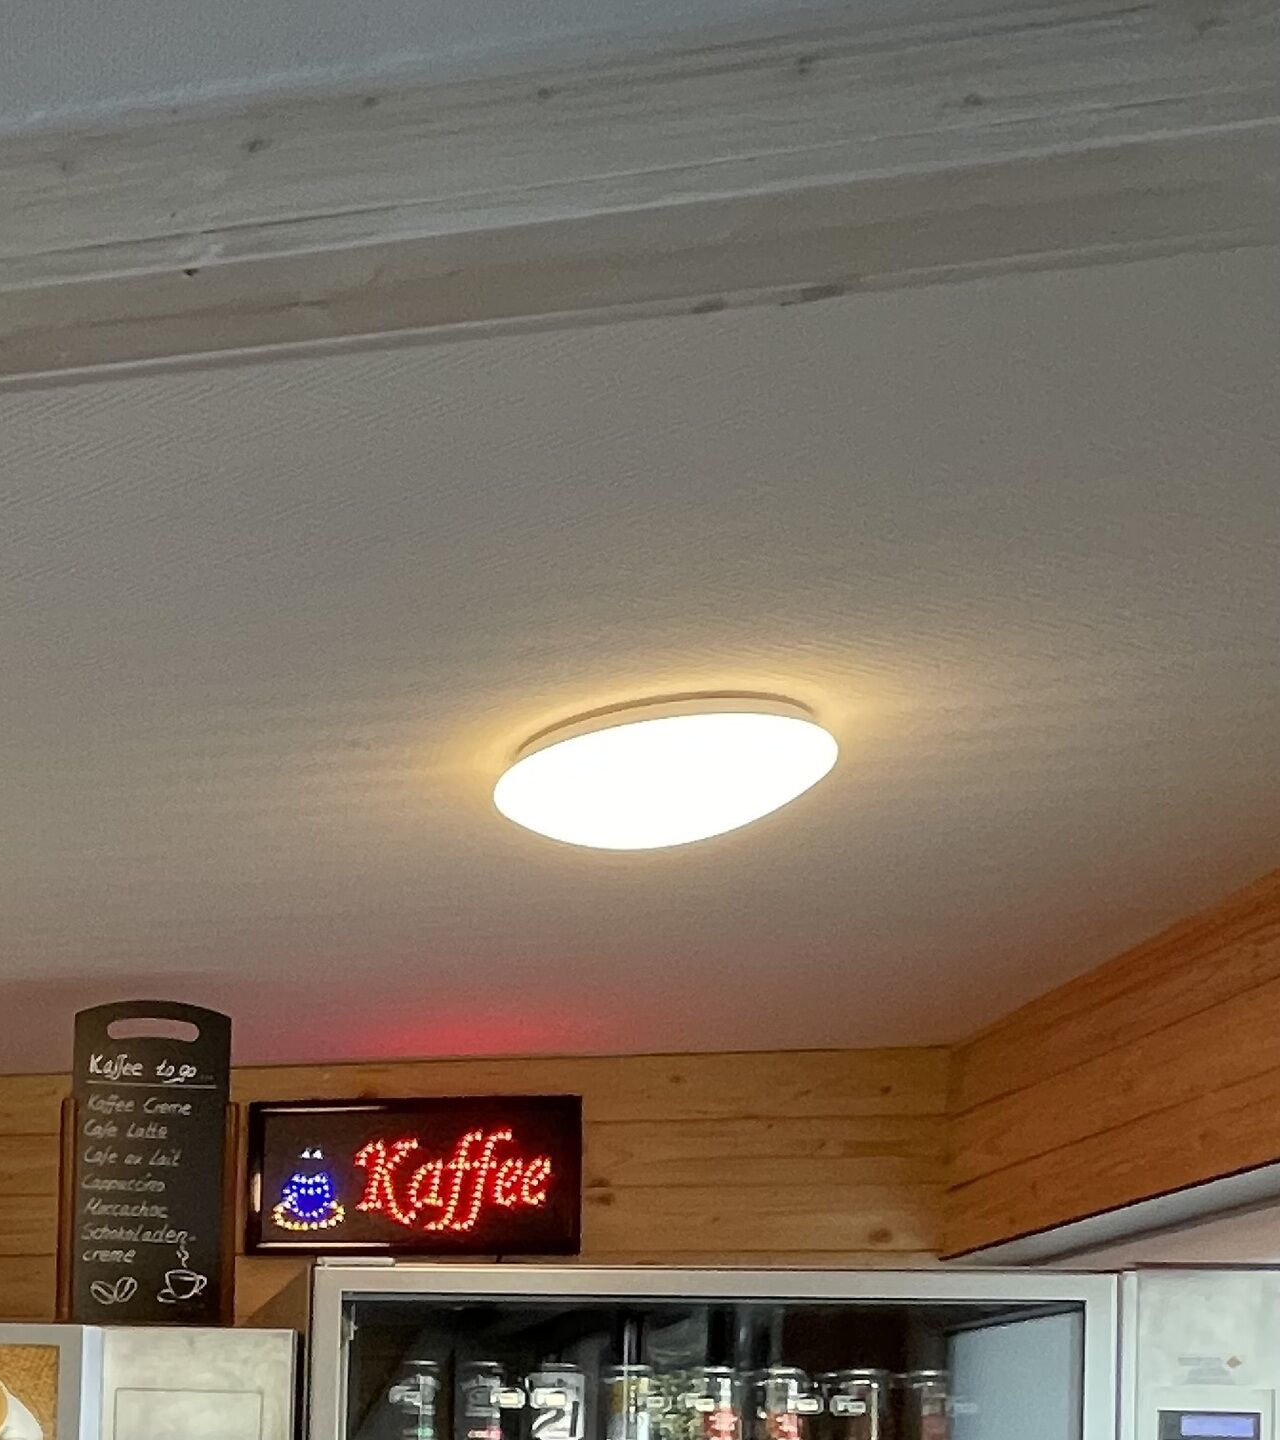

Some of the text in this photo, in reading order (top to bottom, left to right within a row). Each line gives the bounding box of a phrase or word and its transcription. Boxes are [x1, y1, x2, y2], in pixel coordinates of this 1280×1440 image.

[89, 1053, 143, 1080] Kaffee
[156, 1059, 175, 1077] to
[88, 1094, 135, 1114] Kaffee
[353, 1128, 553, 1232] Kaffee
